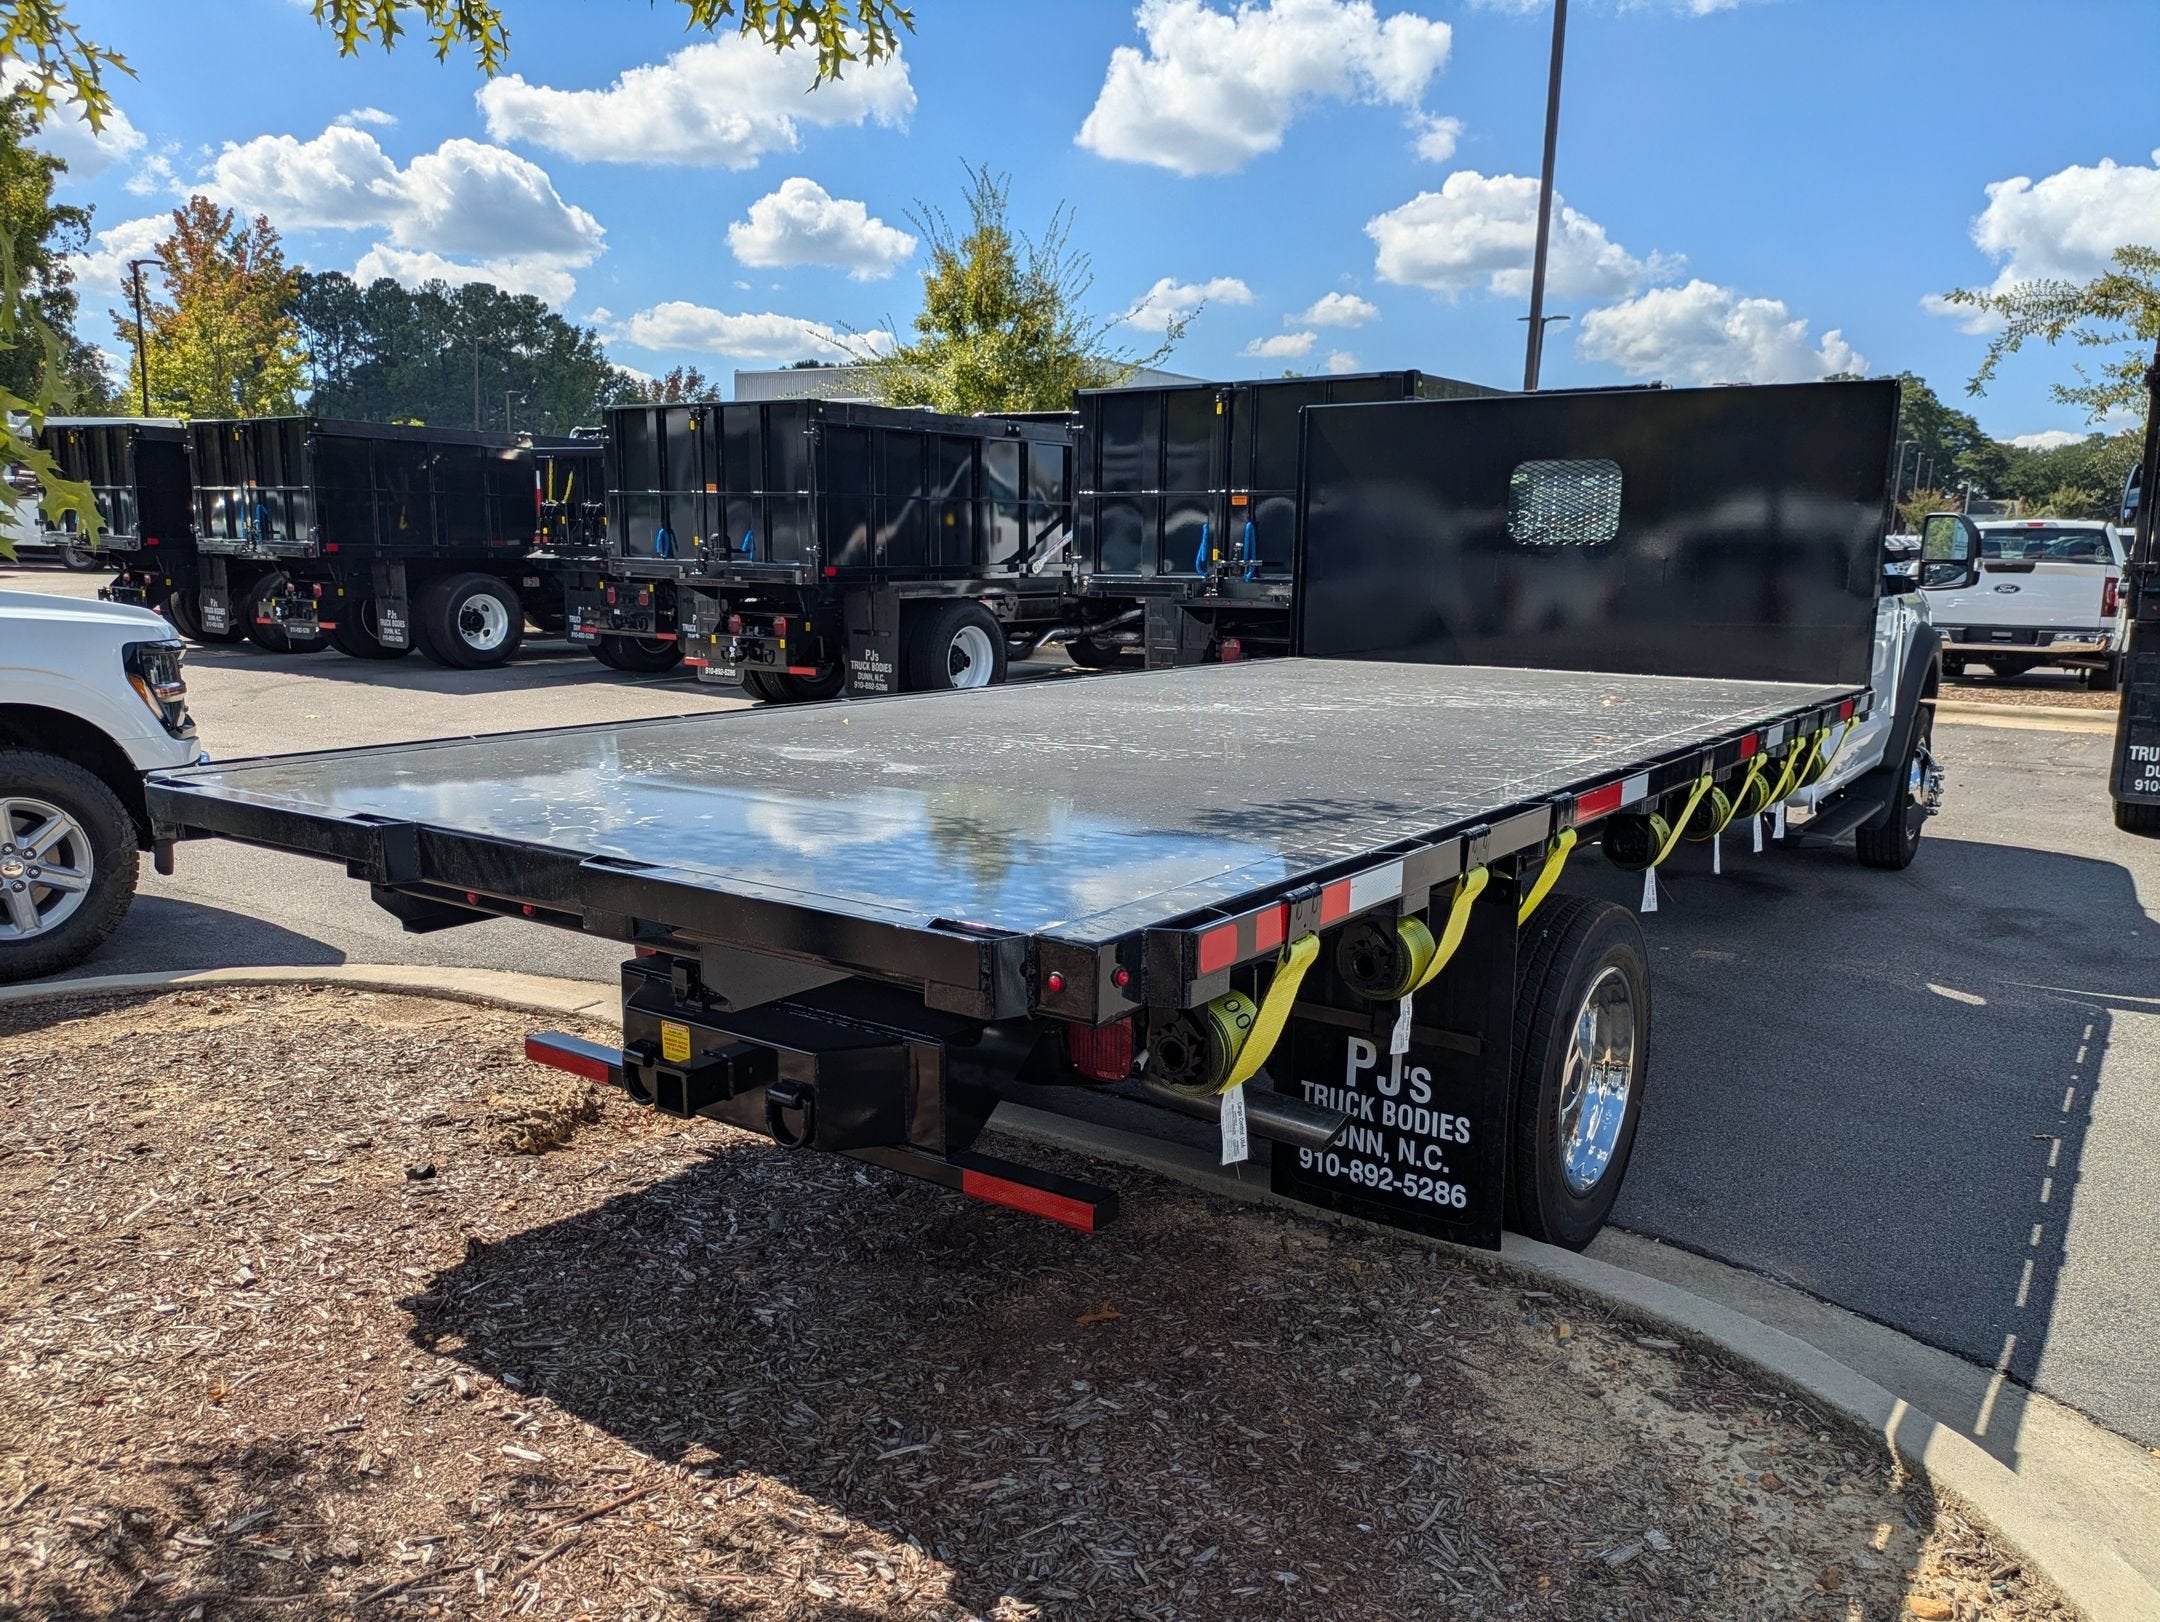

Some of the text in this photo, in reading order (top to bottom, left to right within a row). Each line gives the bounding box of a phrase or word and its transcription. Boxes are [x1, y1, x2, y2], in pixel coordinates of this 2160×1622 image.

[850, 660, 892, 673] TRUCK BODIES
[1301, 1080, 1470, 1144] TRUCK BODIES
[1334, 1125, 1449, 1173] UNN, N.C.
[1300, 1148, 1467, 1208] 910-892-5286
